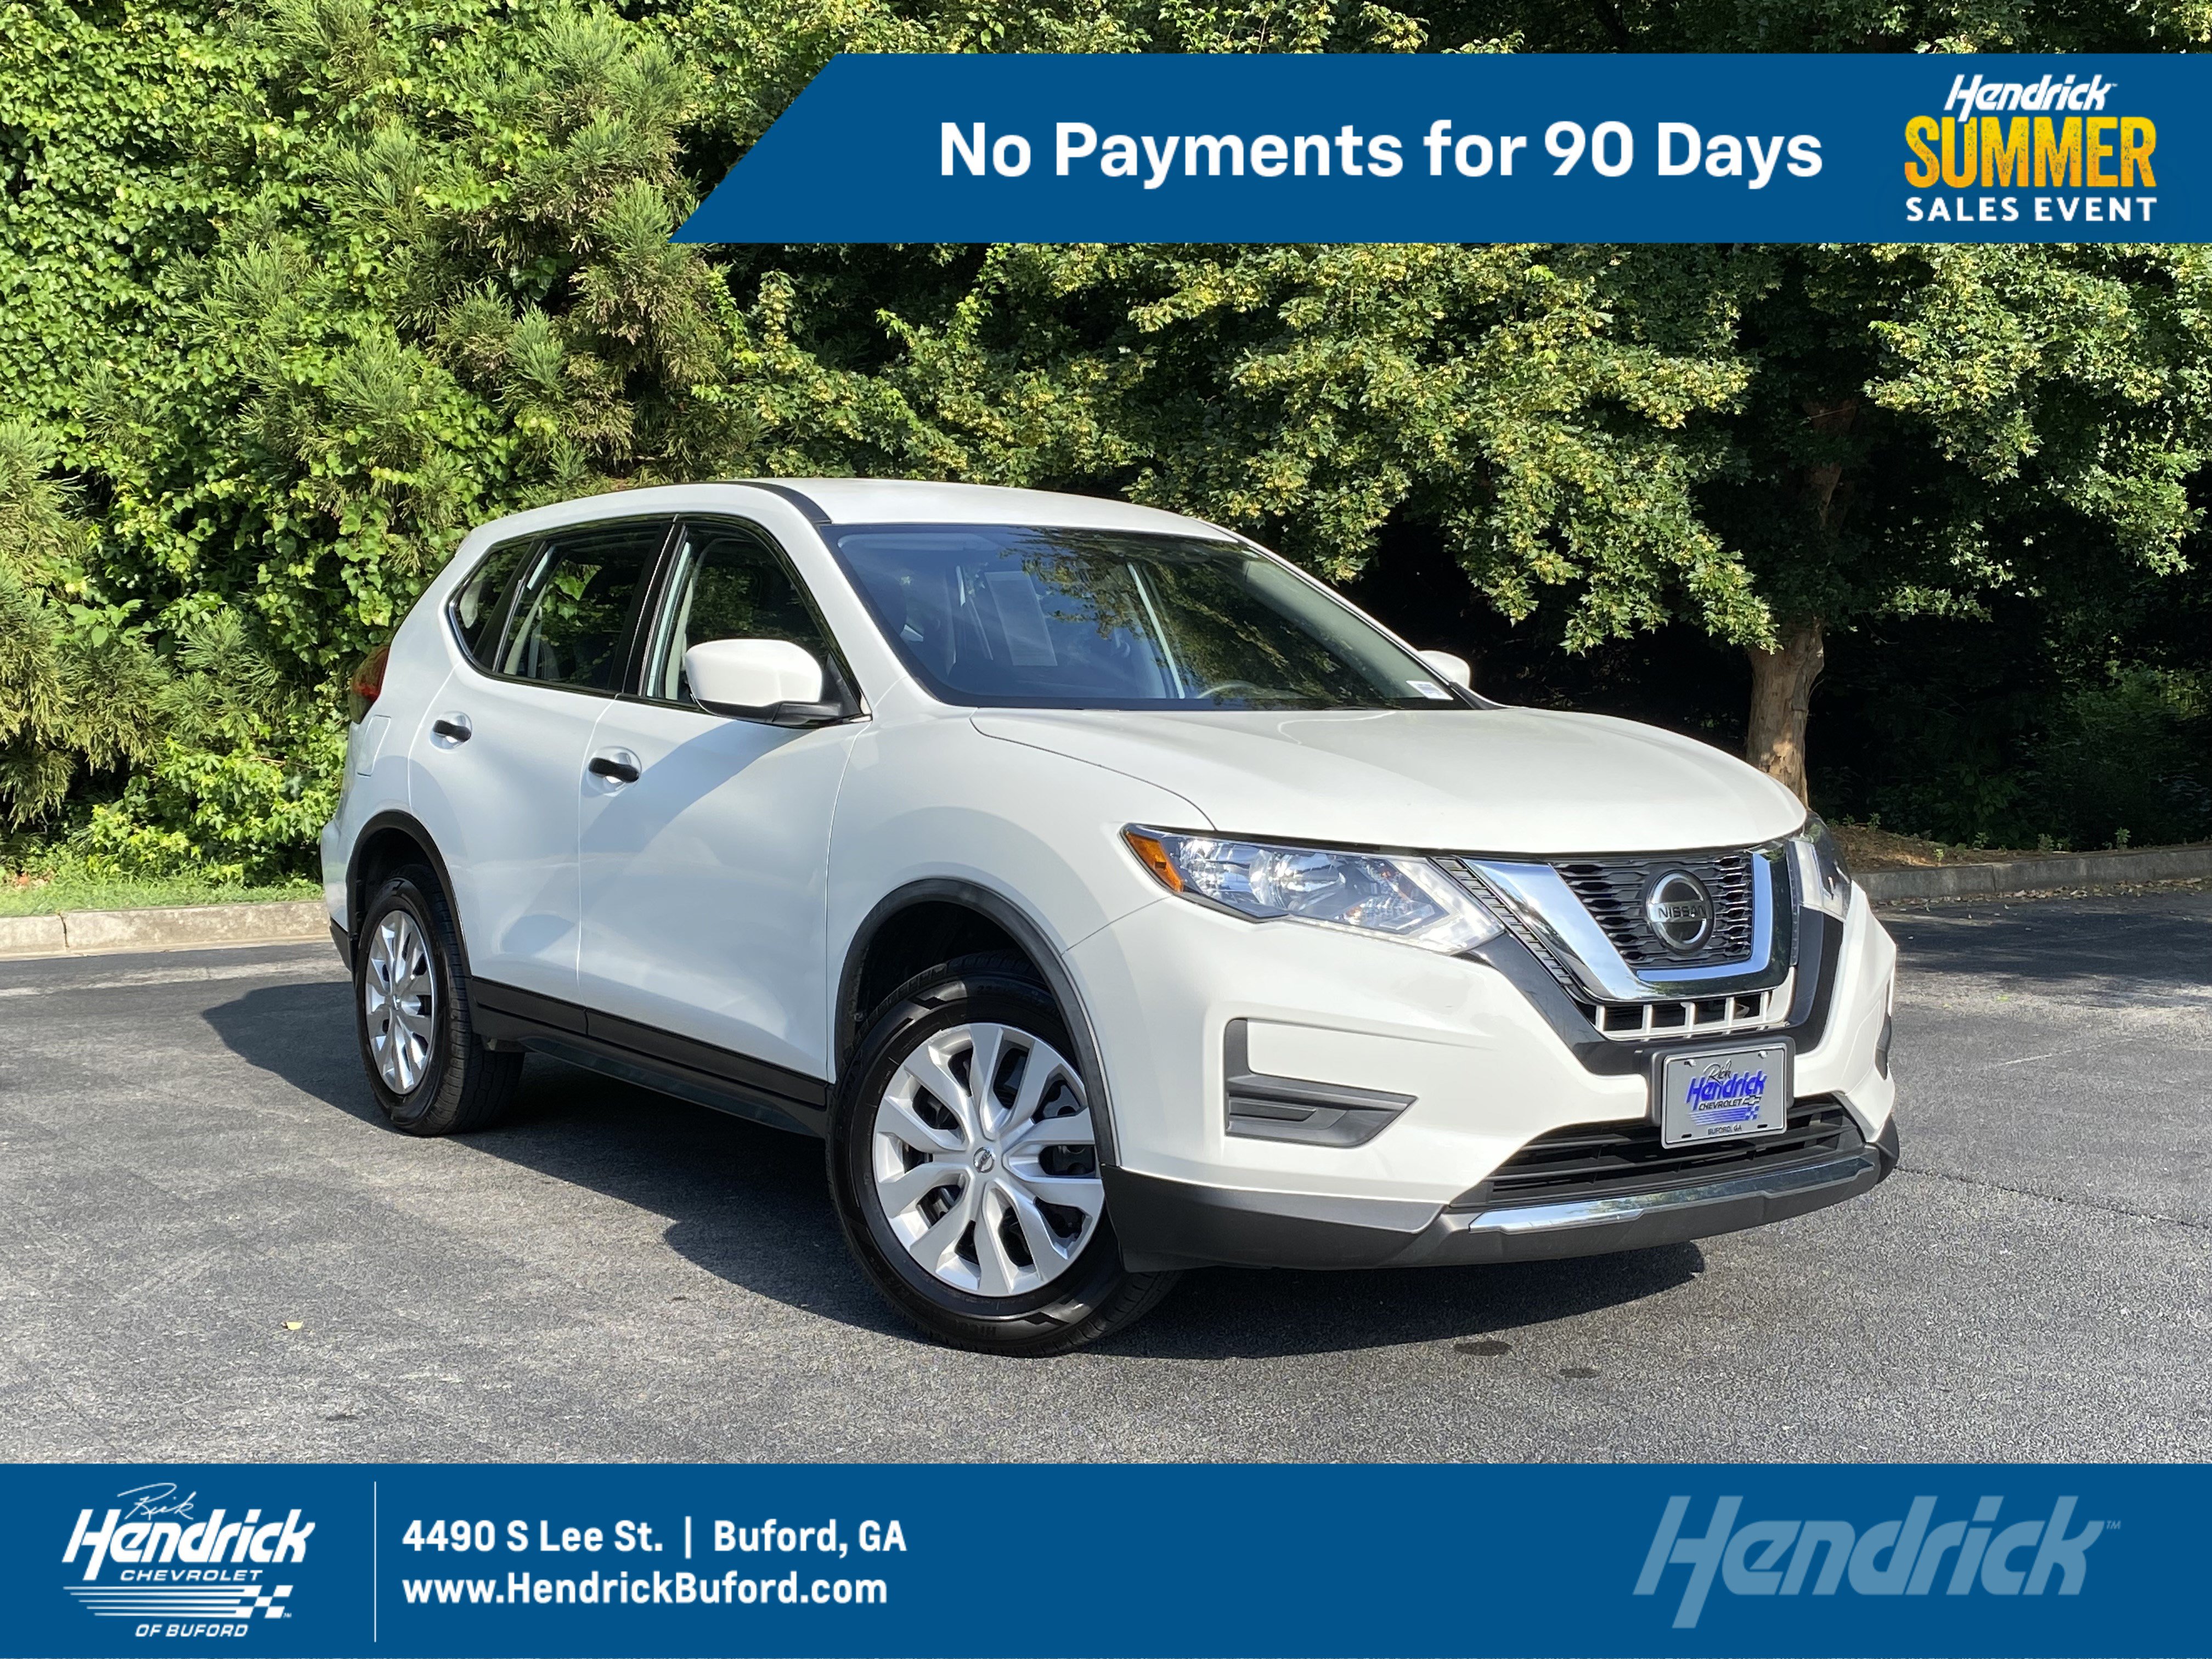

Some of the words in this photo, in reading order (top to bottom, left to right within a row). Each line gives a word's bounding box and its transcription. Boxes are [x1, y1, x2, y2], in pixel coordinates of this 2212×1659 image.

[1658, 906, 1707, 918] NISSAN
[1686, 1070, 1768, 1111] Hendrick
[1698, 1098, 1743, 1111] CHEVROLET
